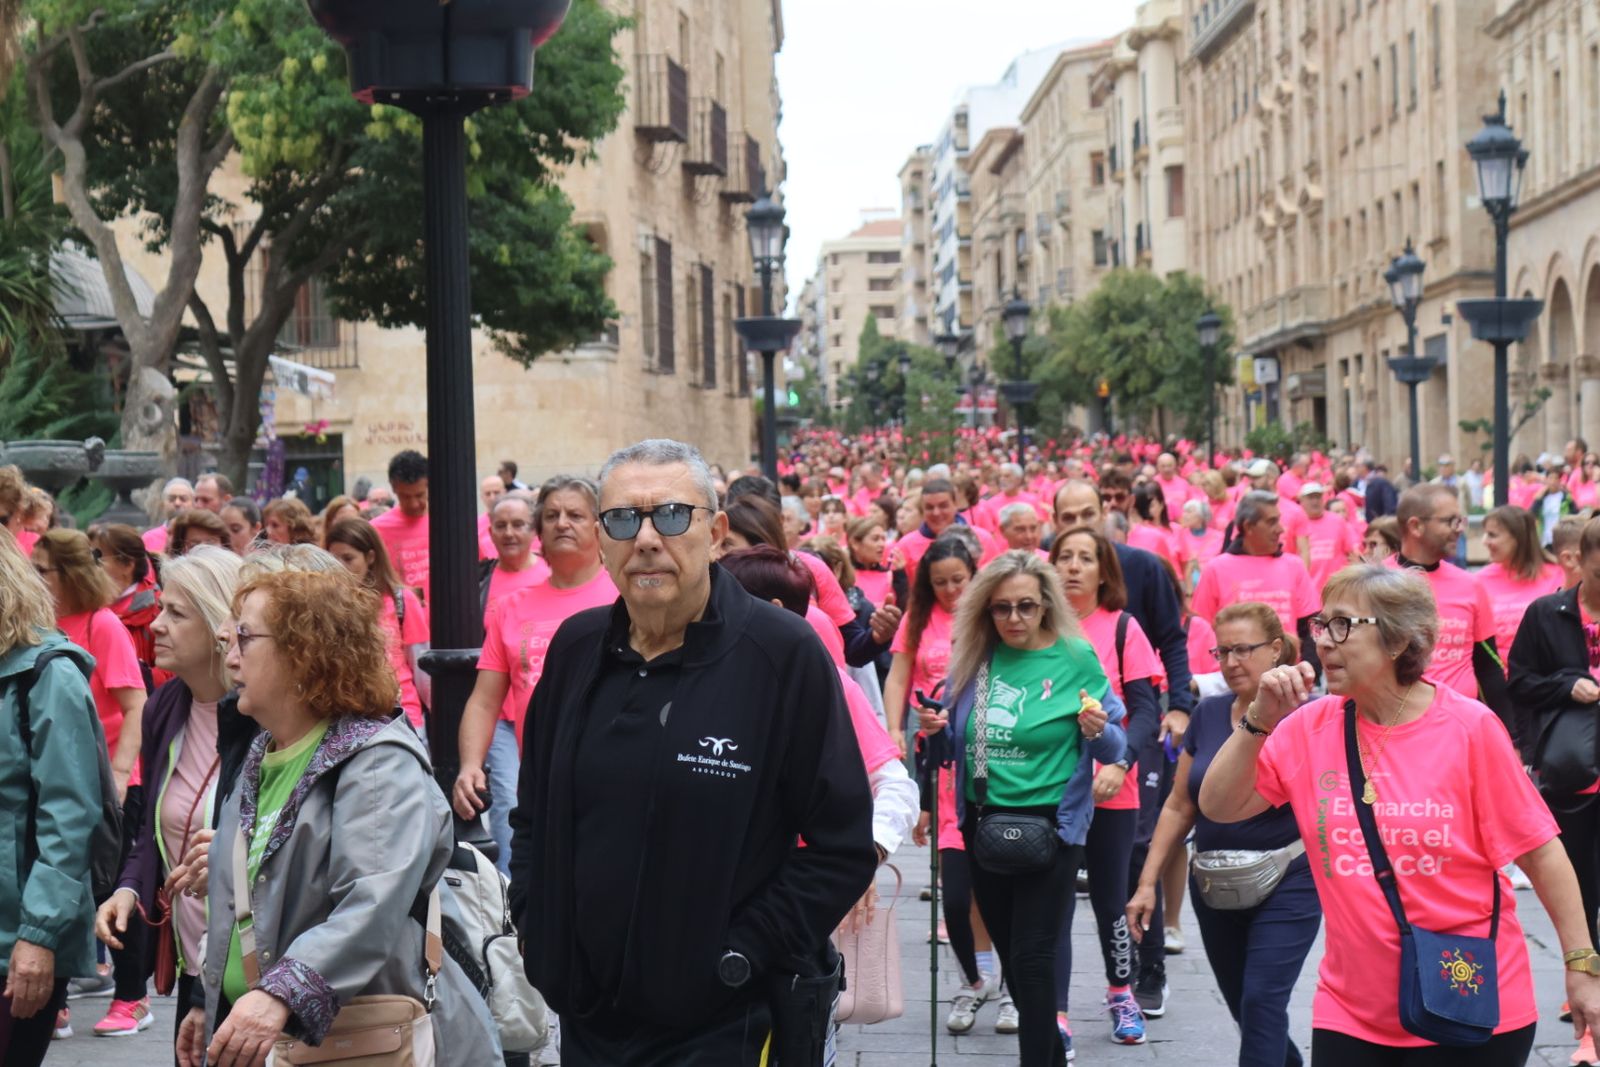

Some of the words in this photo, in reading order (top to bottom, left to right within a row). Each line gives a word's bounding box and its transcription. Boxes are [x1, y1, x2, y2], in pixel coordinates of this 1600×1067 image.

[985, 727, 1013, 741] ecc
[677, 753, 697, 763] Bufete
[698, 755, 721, 767] Enrique
[721, 759, 729, 767] de
[729, 760, 752, 773] Santiago
[692, 767, 737, 779] ABOGADOS
[1331, 824, 1419, 846] cotra
[1423, 824, 1452, 848] el
[1335, 849, 1452, 877] cácer
[1110, 915, 1131, 978] adidas
